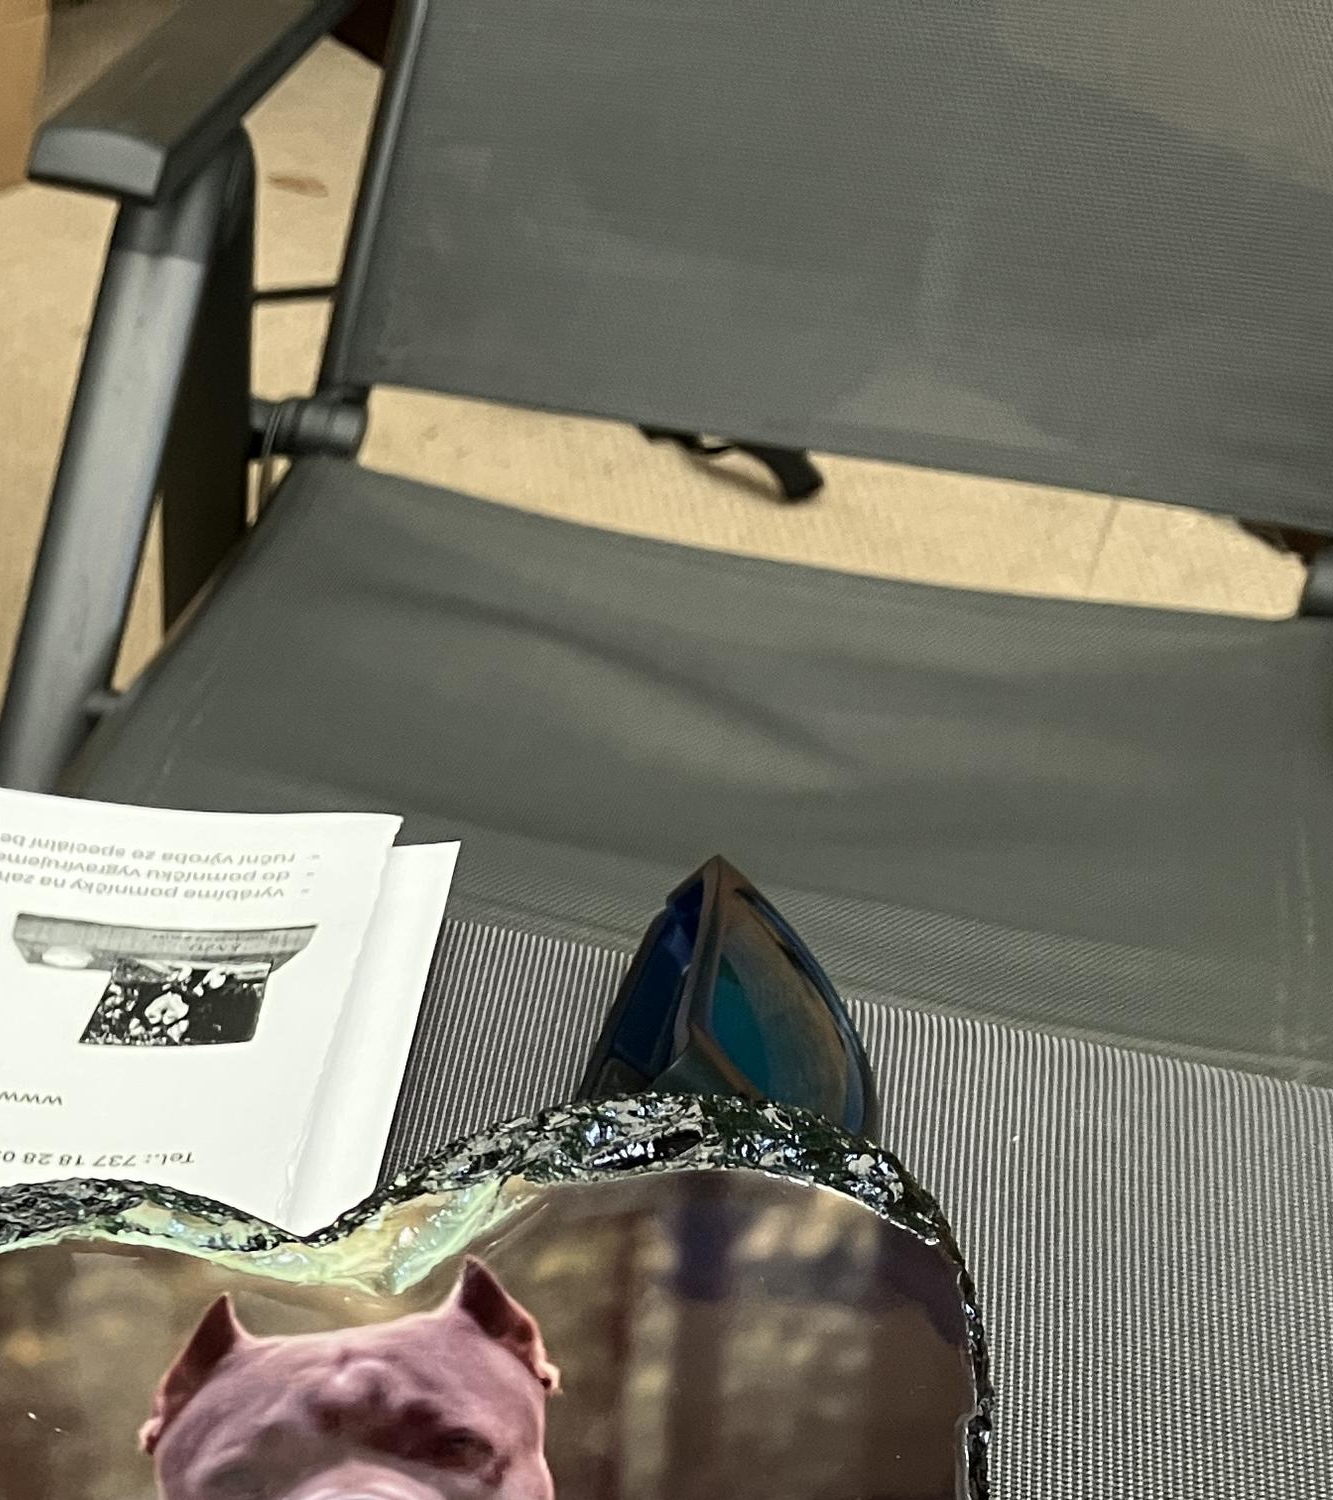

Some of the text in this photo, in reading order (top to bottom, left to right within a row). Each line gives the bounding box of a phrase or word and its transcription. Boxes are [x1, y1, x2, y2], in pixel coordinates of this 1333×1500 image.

[24, 1151, 52, 1166] 28
[59, 1152, 86, 1167] 18
[93, 1153, 138, 1168] 737
[145, 1150, 196, 1165] Tel.:
